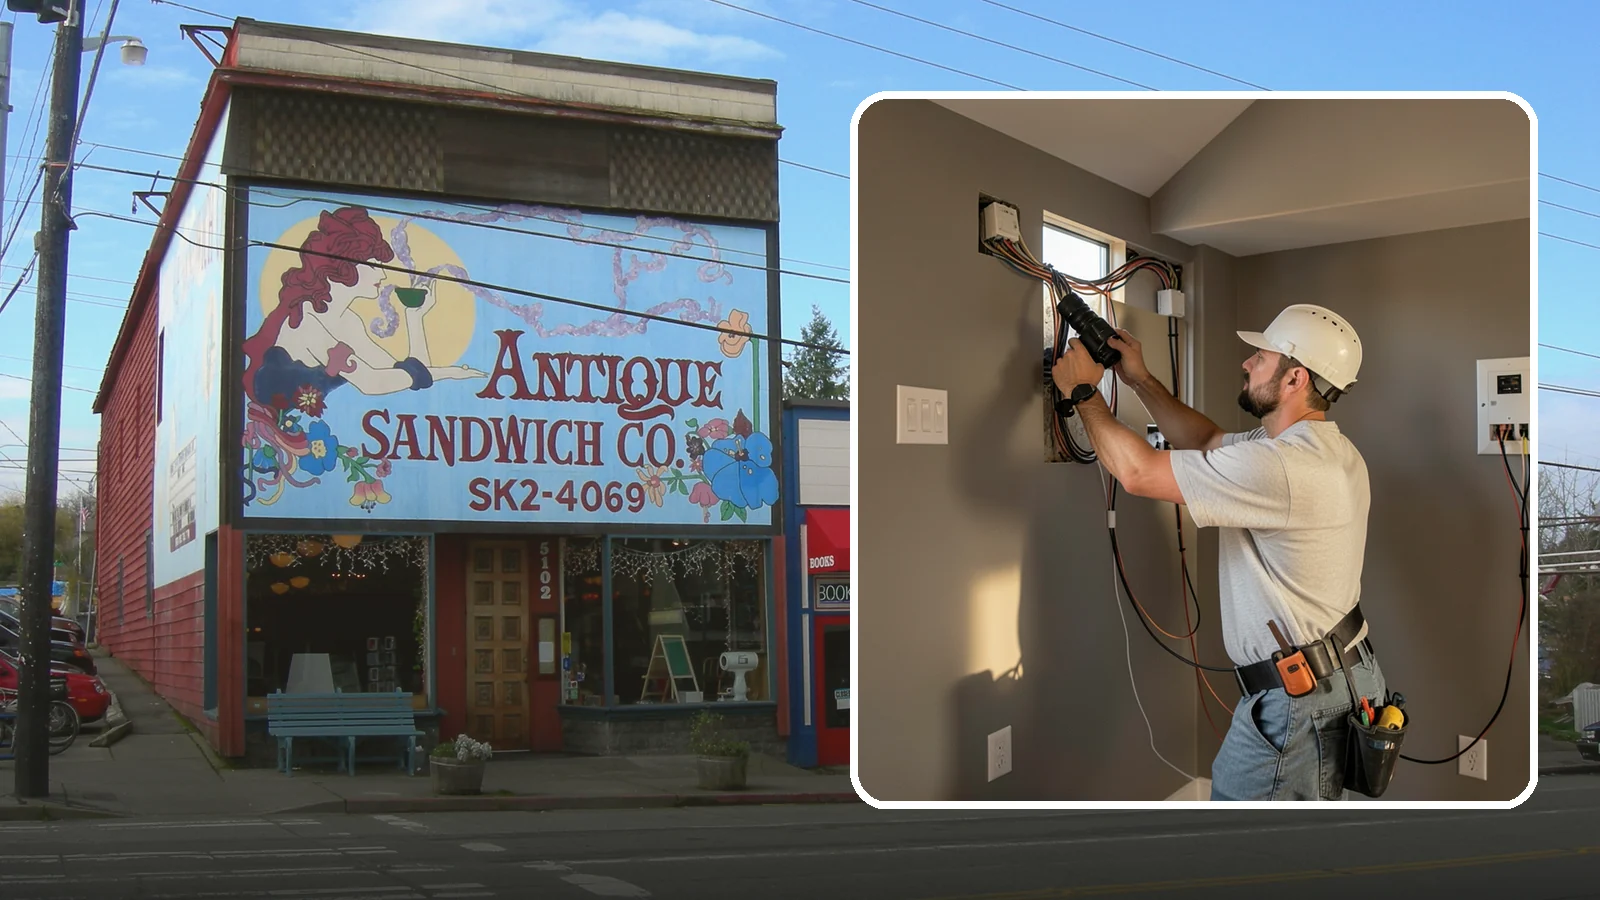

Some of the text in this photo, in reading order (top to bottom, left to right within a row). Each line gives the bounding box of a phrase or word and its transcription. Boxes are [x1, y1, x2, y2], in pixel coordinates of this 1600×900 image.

[476, 329, 724, 420] ANTIQUE
[361, 408, 686, 469] SANDWICH CO.
[468, 478, 646, 514] SK2-4069
[540, 541, 552, 600] 5102
[809, 555, 835, 569] BOOKS
